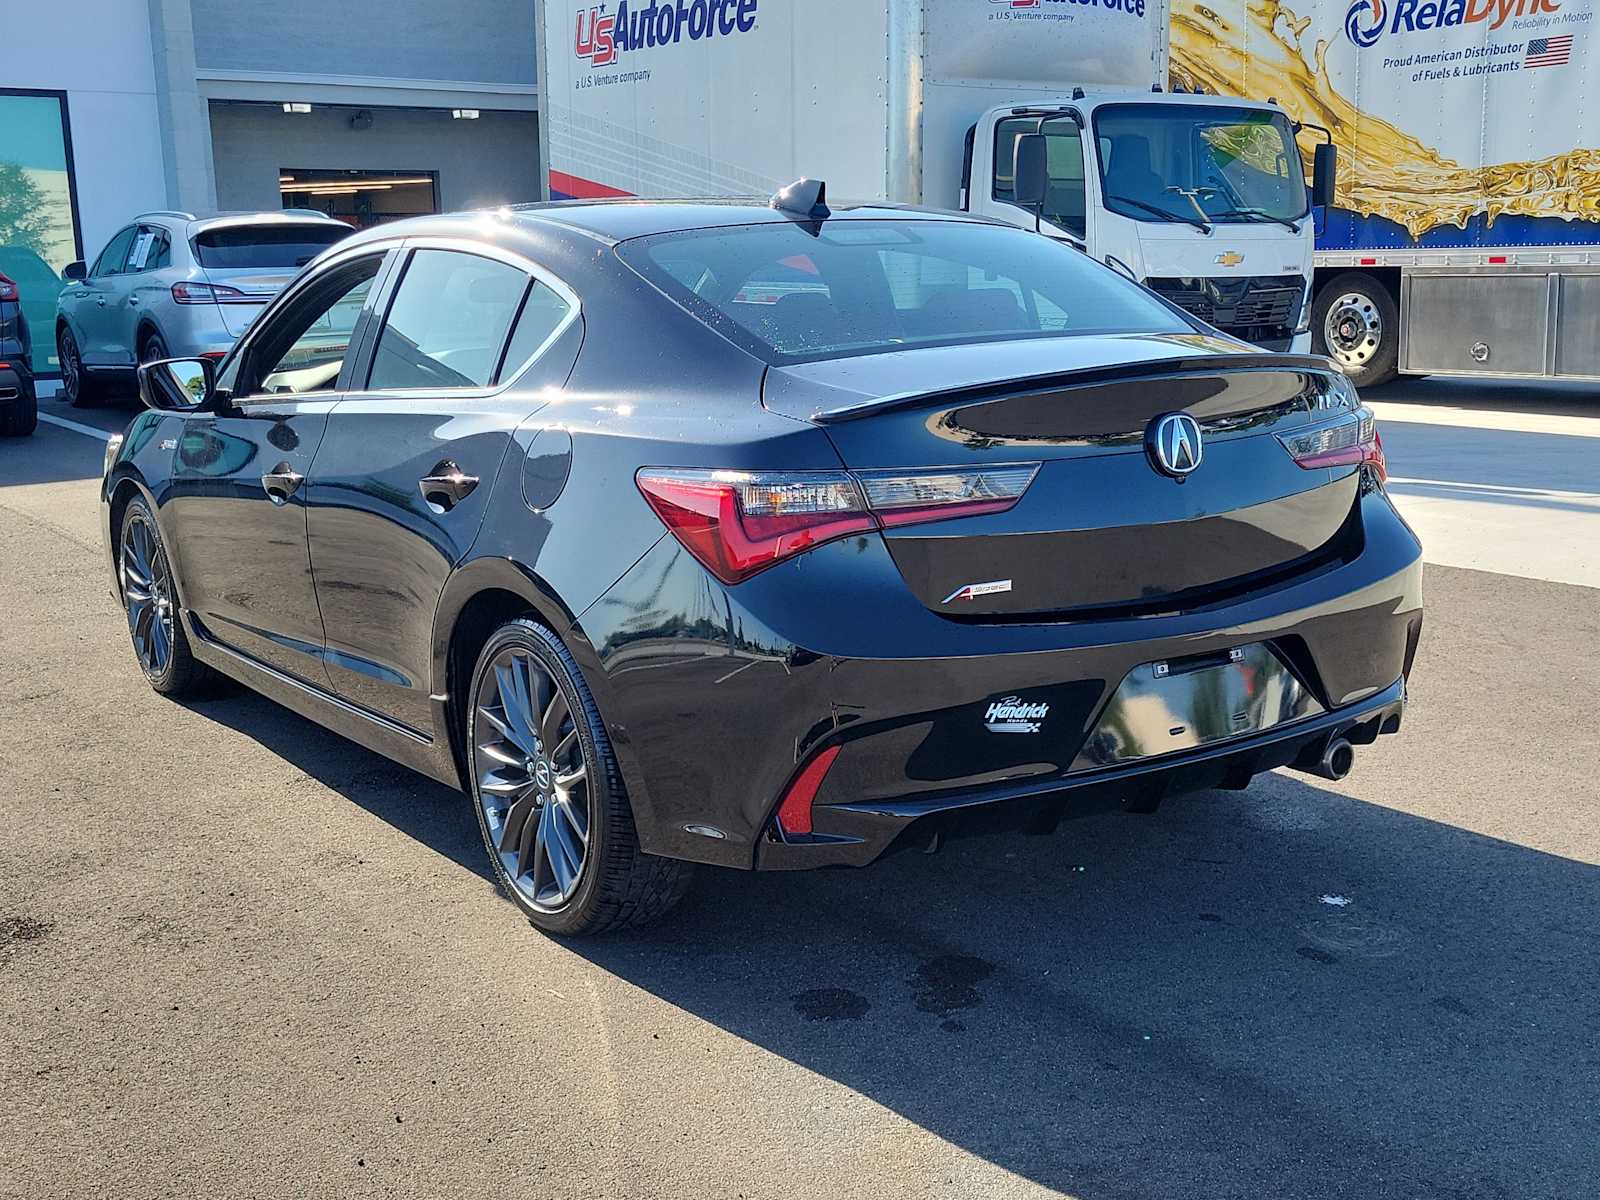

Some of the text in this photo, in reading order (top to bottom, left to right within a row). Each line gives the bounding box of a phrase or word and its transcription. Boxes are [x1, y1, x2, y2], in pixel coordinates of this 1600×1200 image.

[1013, 12, 1041, 20] Venture
[1043, 13, 1075, 23] company
[1511, 12, 1593, 31] Reliability in Motion
[1383, 42, 1524, 68] Proud American Distributor
[594, 72, 619, 86] Venture
[620, 69, 651, 83] company
[1412, 60, 1520, 82] of Fuels & Lubricants
[985, 703, 1049, 723] Hendrick
